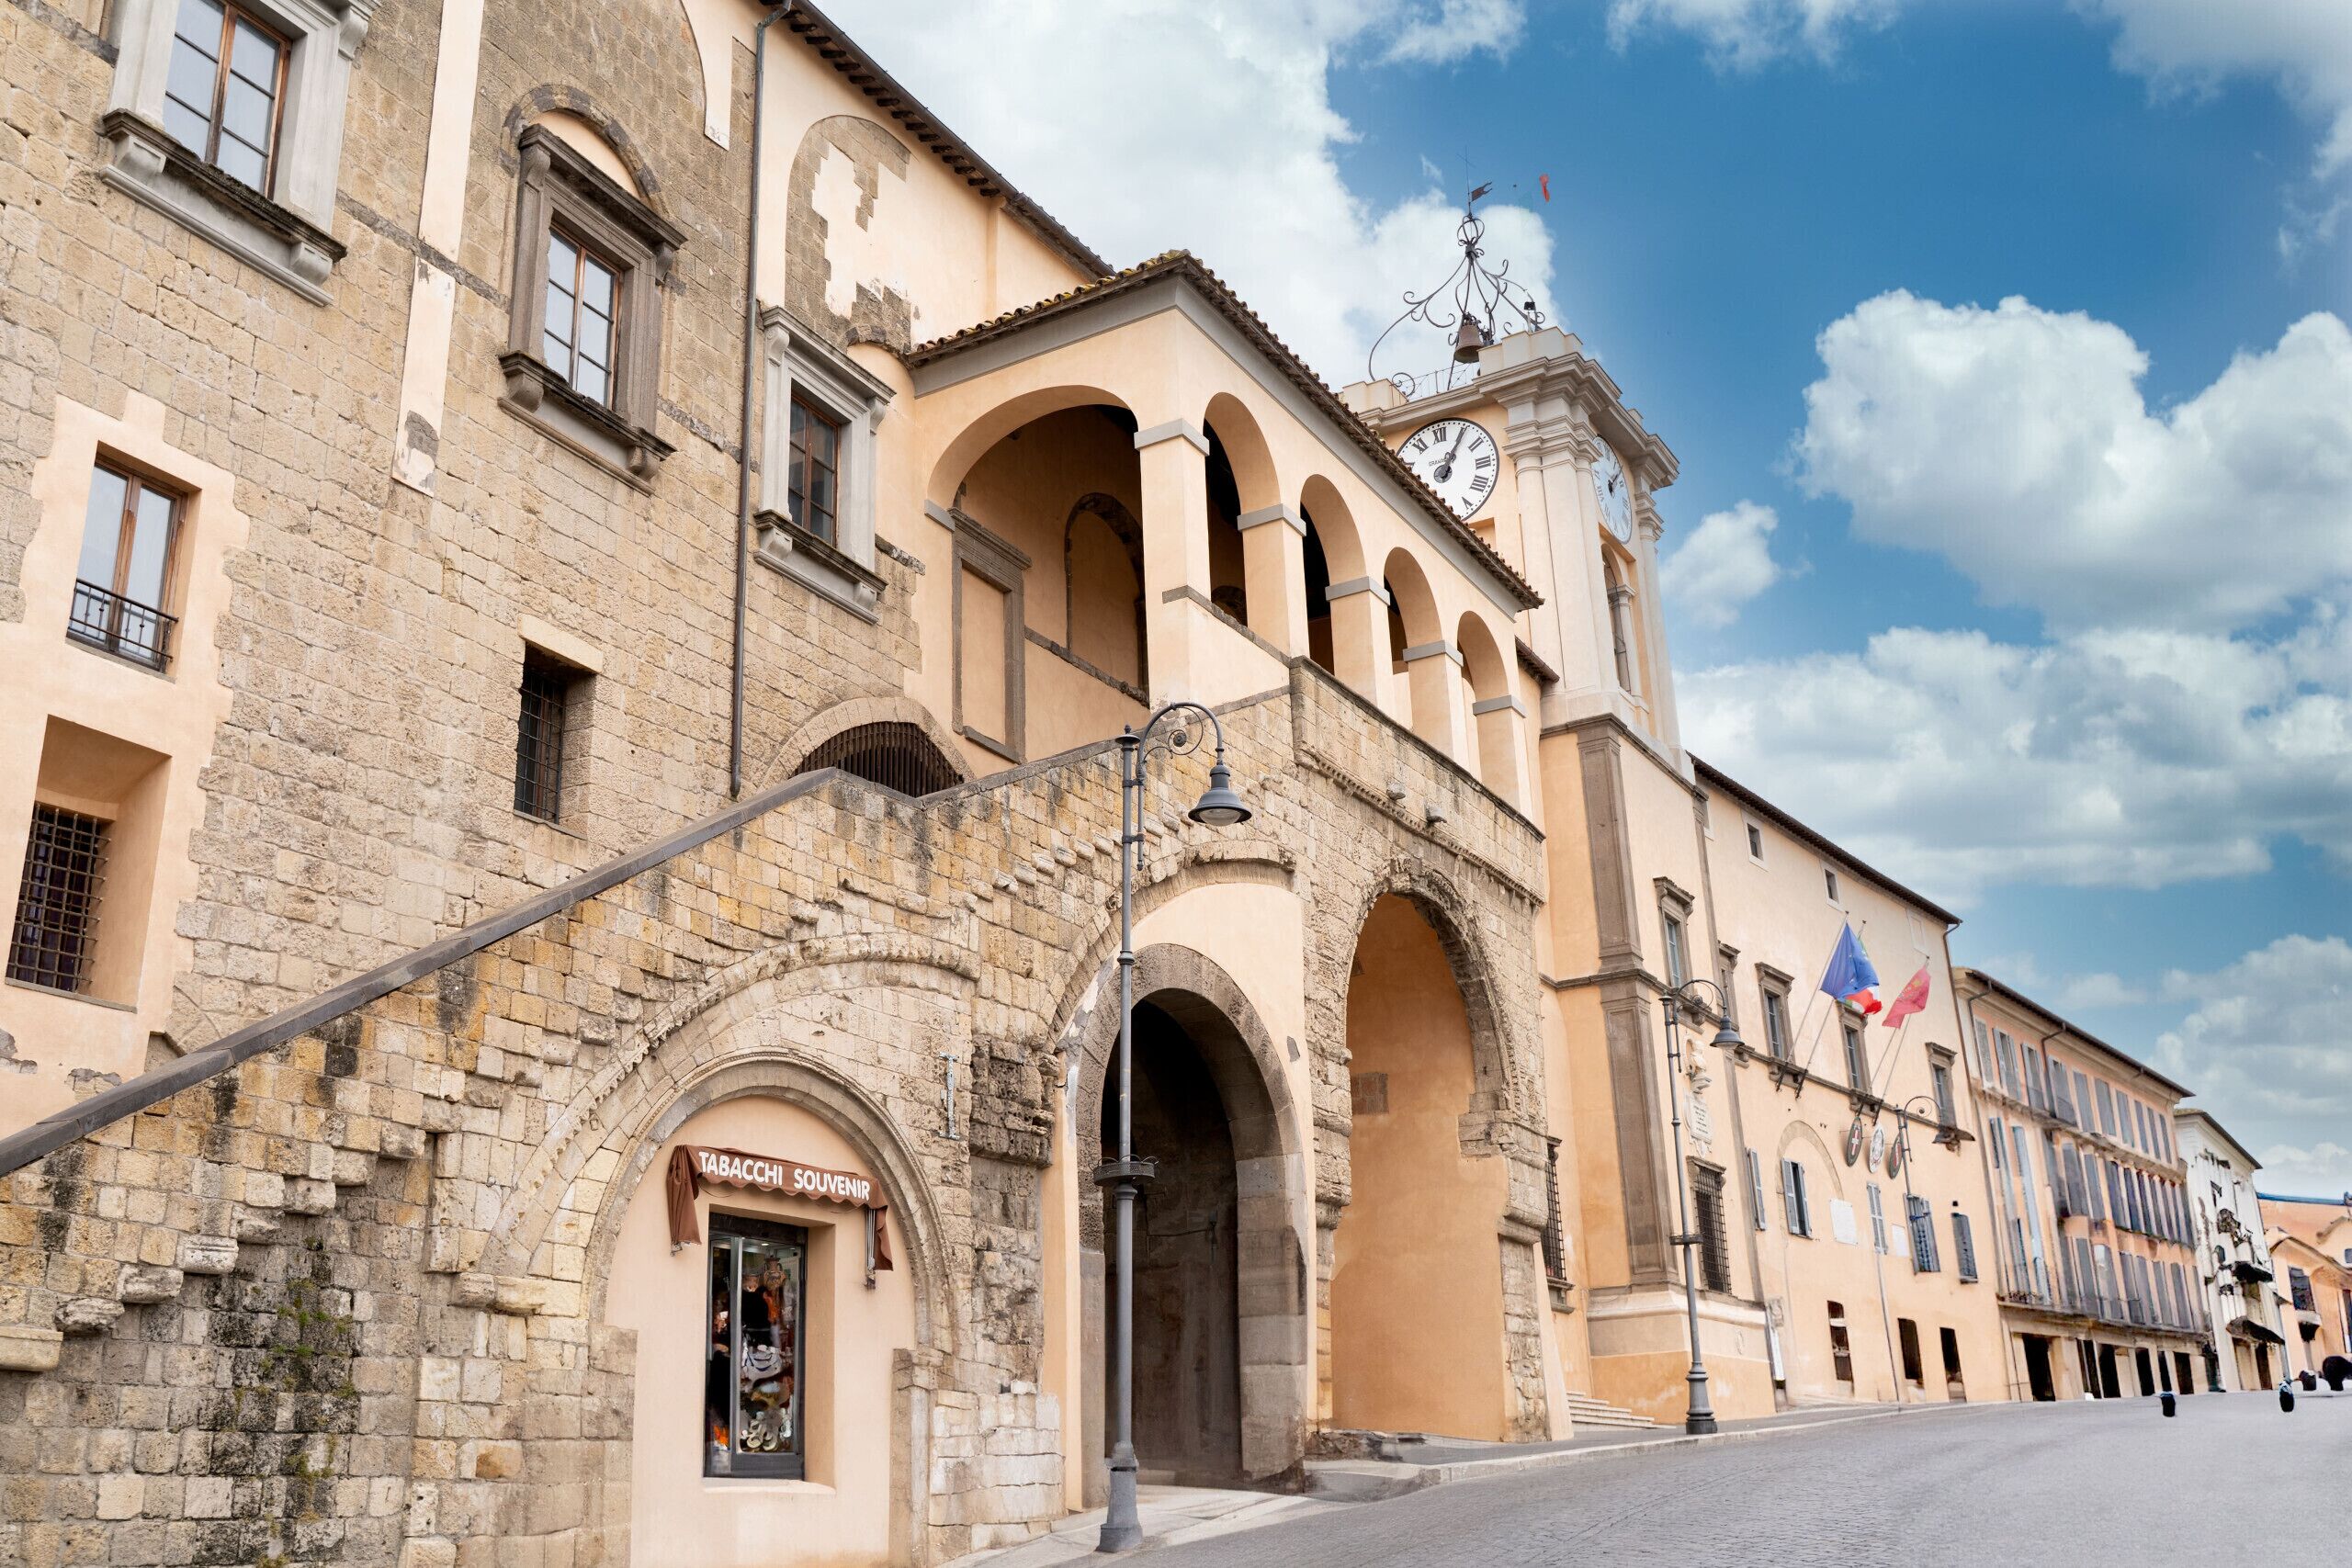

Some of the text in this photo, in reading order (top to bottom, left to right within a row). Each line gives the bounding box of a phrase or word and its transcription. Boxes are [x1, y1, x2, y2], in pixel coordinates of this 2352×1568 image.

[1432, 426, 1447, 445] XII
[1468, 436, 1484, 453] II
[1412, 437, 1430, 455] XI
[1475, 455, 1491, 470] III
[1470, 475, 1490, 493] IIII
[698, 1151, 871, 1201] TABACCHI SOUVENIR
